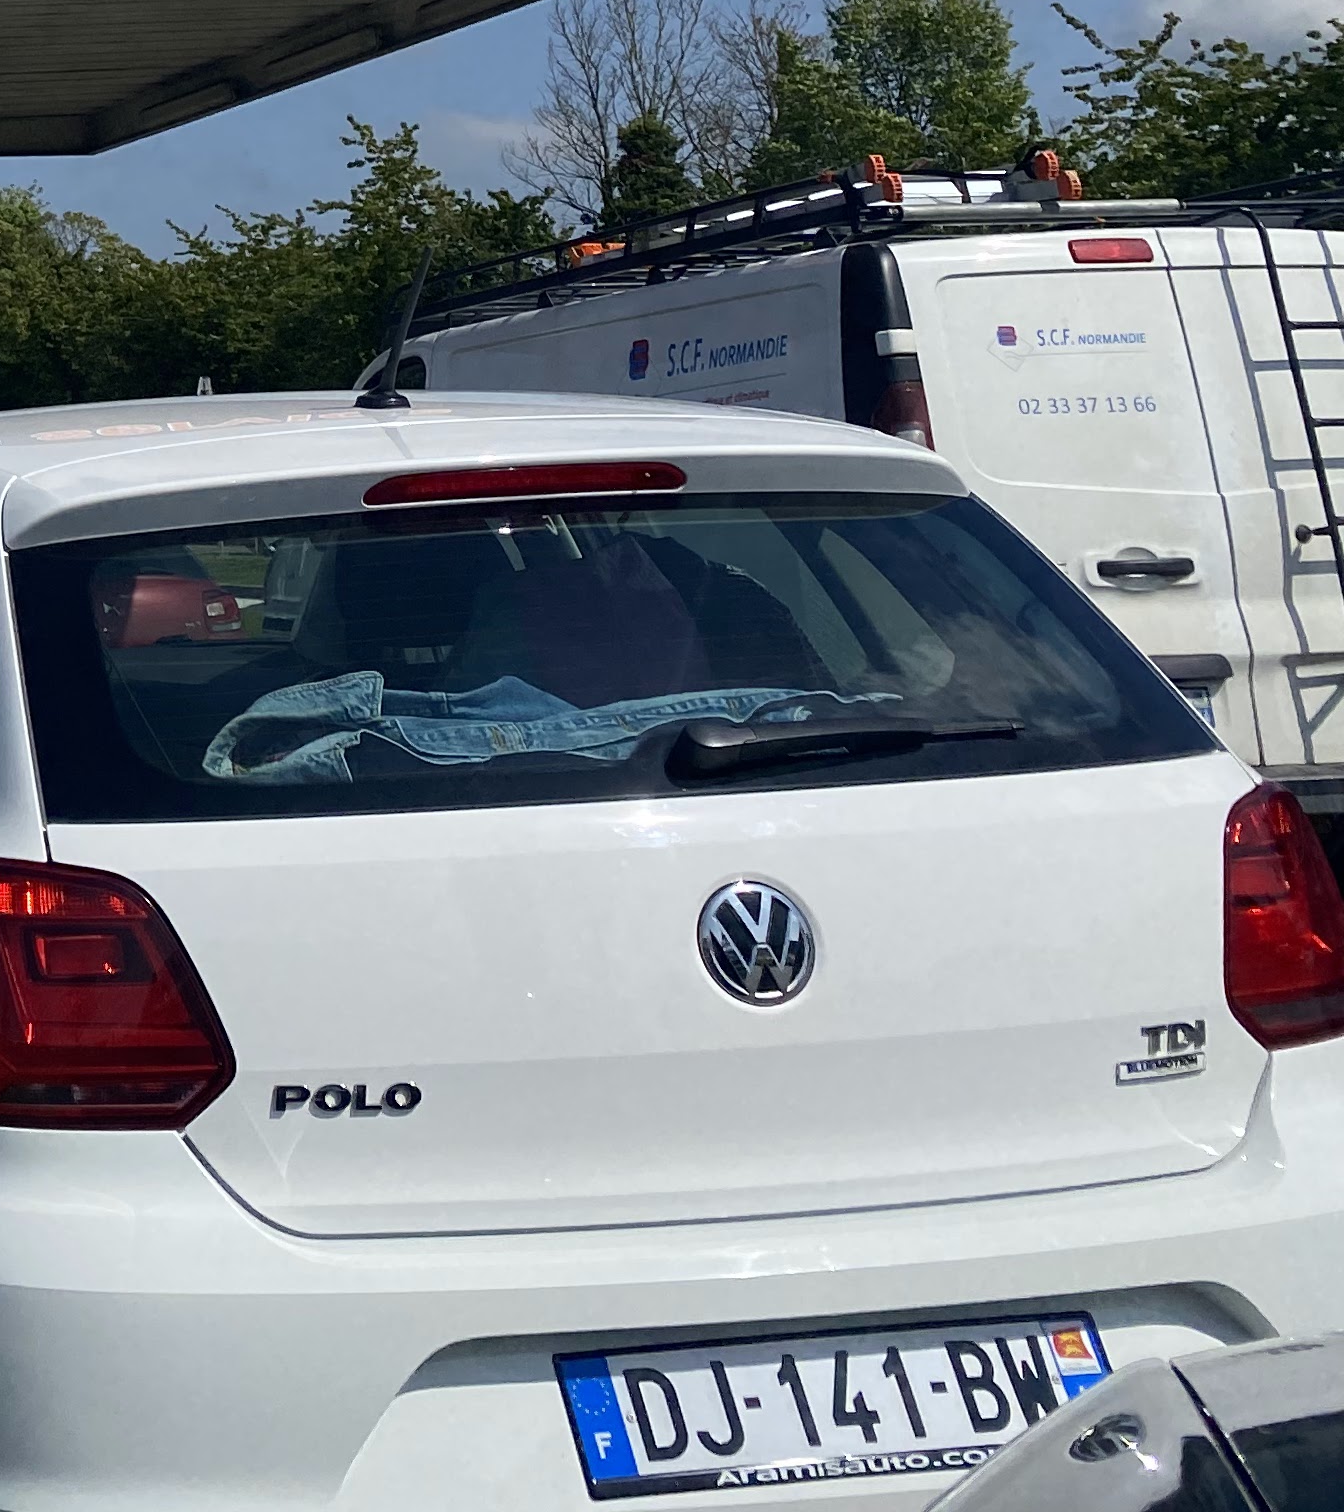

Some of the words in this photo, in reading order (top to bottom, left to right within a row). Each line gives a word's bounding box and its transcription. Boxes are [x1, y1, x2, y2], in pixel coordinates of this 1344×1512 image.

[666, 338, 705, 377] S.C.F.
[708, 334, 788, 370] NORMANDIE
[1036, 329, 1075, 347] S.C.F.
[1078, 332, 1147, 345] NORMANDIE
[1018, 398, 1043, 415] 02
[1047, 397, 1071, 414] 33
[1075, 397, 1097, 414] 37
[1105, 396, 1128, 413] 13
[1133, 395, 1157, 413] 66
[1140, 1019, 1206, 1056] TDI
[270, 1082, 422, 1119] POLO
[622, 1335, 1061, 1463] DJ-141-BW
[593, 1431, 612, 1460] F
[716, 1448, 996, 1488] Aramisauto.co
